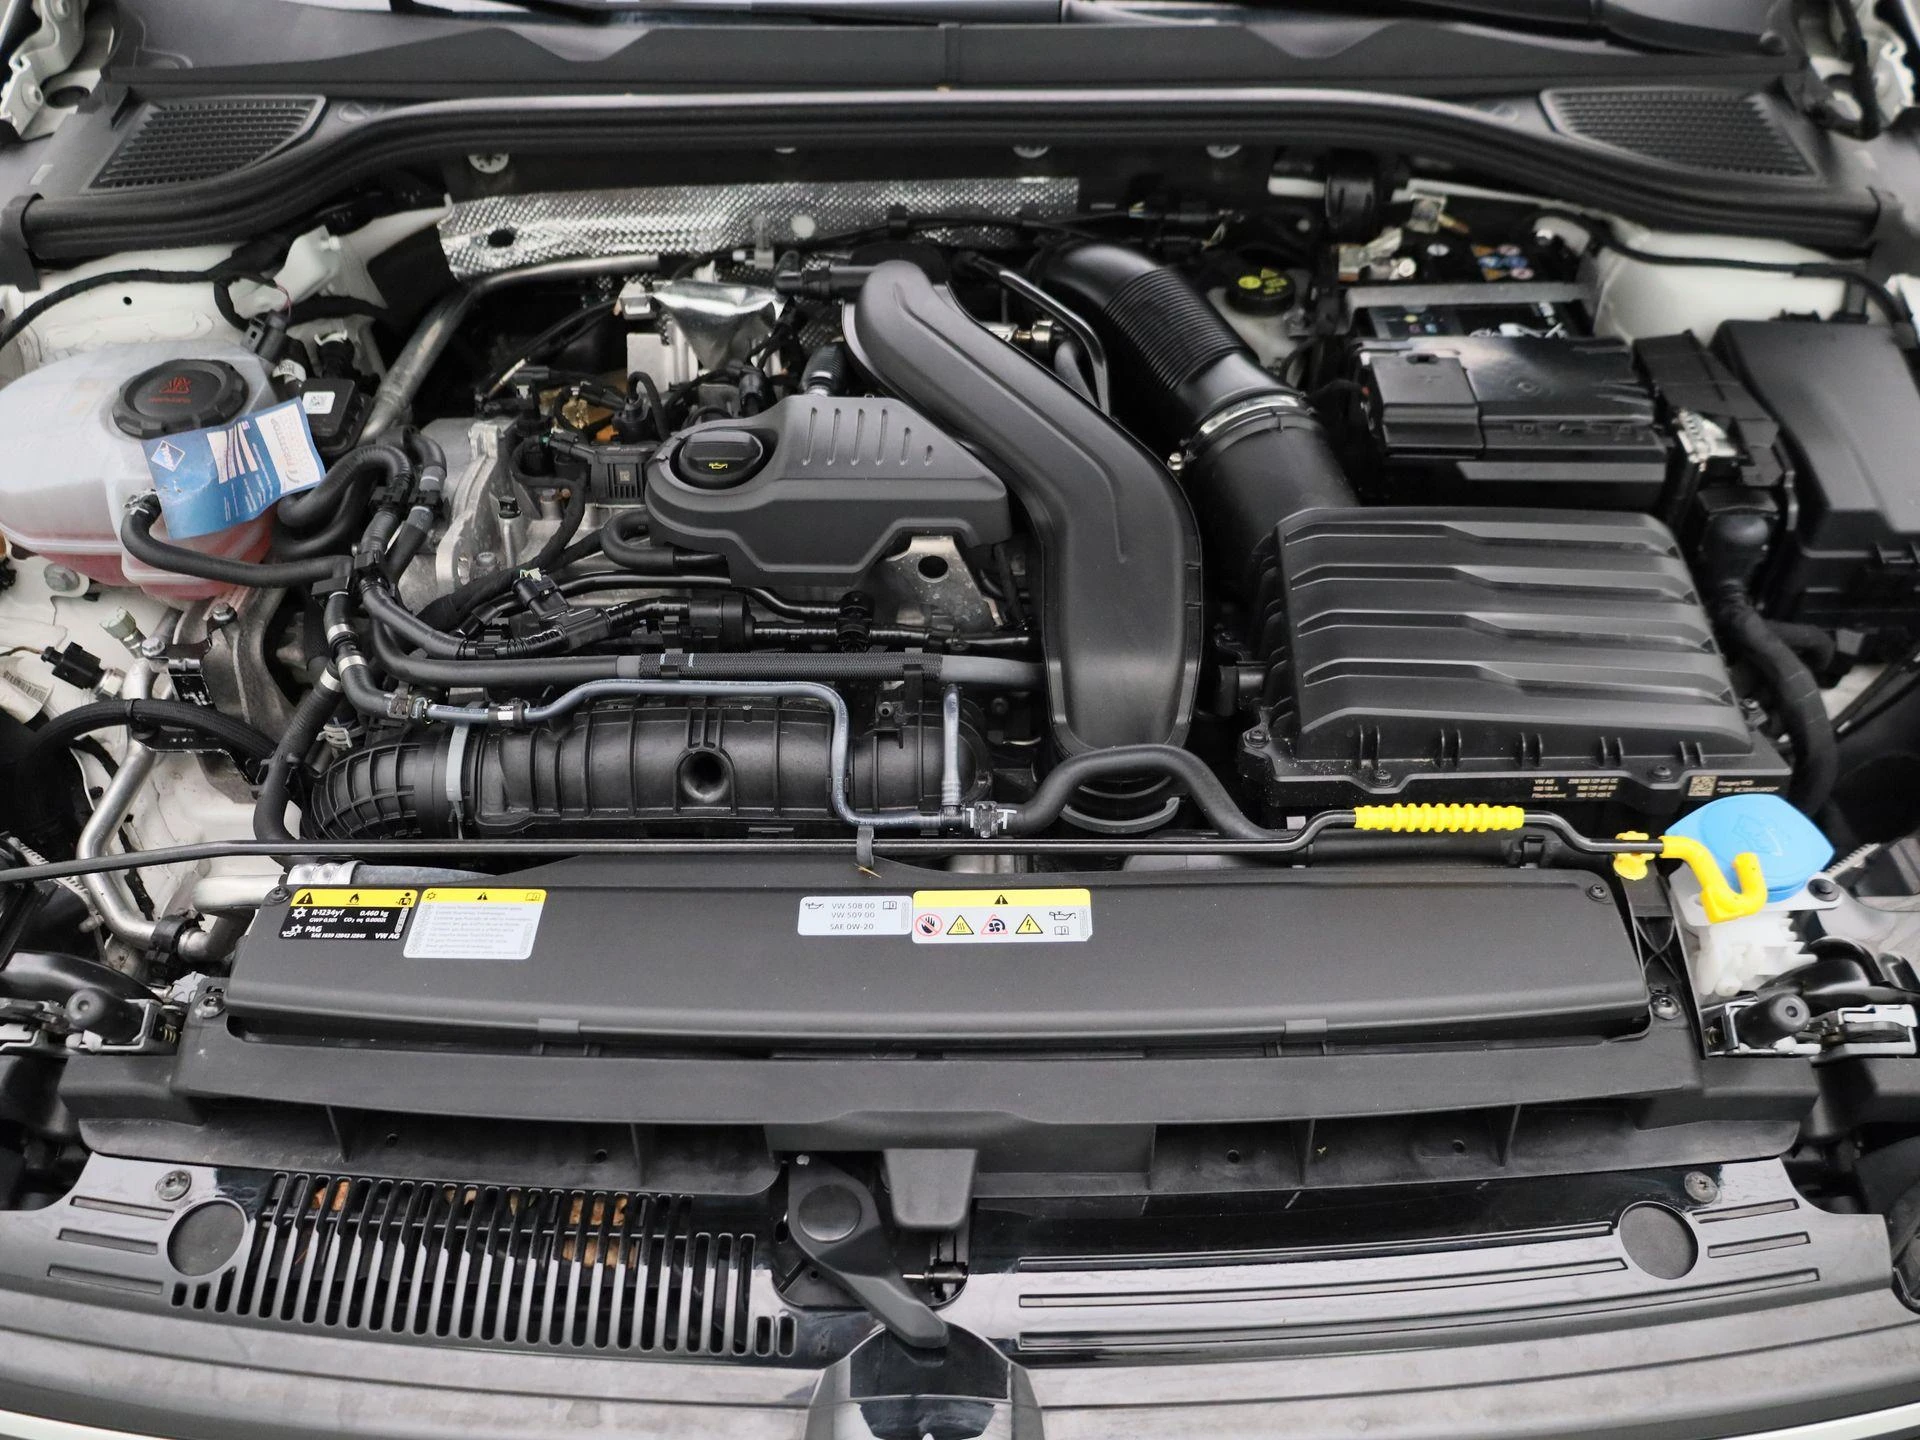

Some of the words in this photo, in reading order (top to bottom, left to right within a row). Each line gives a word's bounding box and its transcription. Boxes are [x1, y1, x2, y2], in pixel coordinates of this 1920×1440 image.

[311, 908, 346, 918] R-1234yf
[380, 910, 390, 918] kg
[304, 925, 323, 933] PAG
